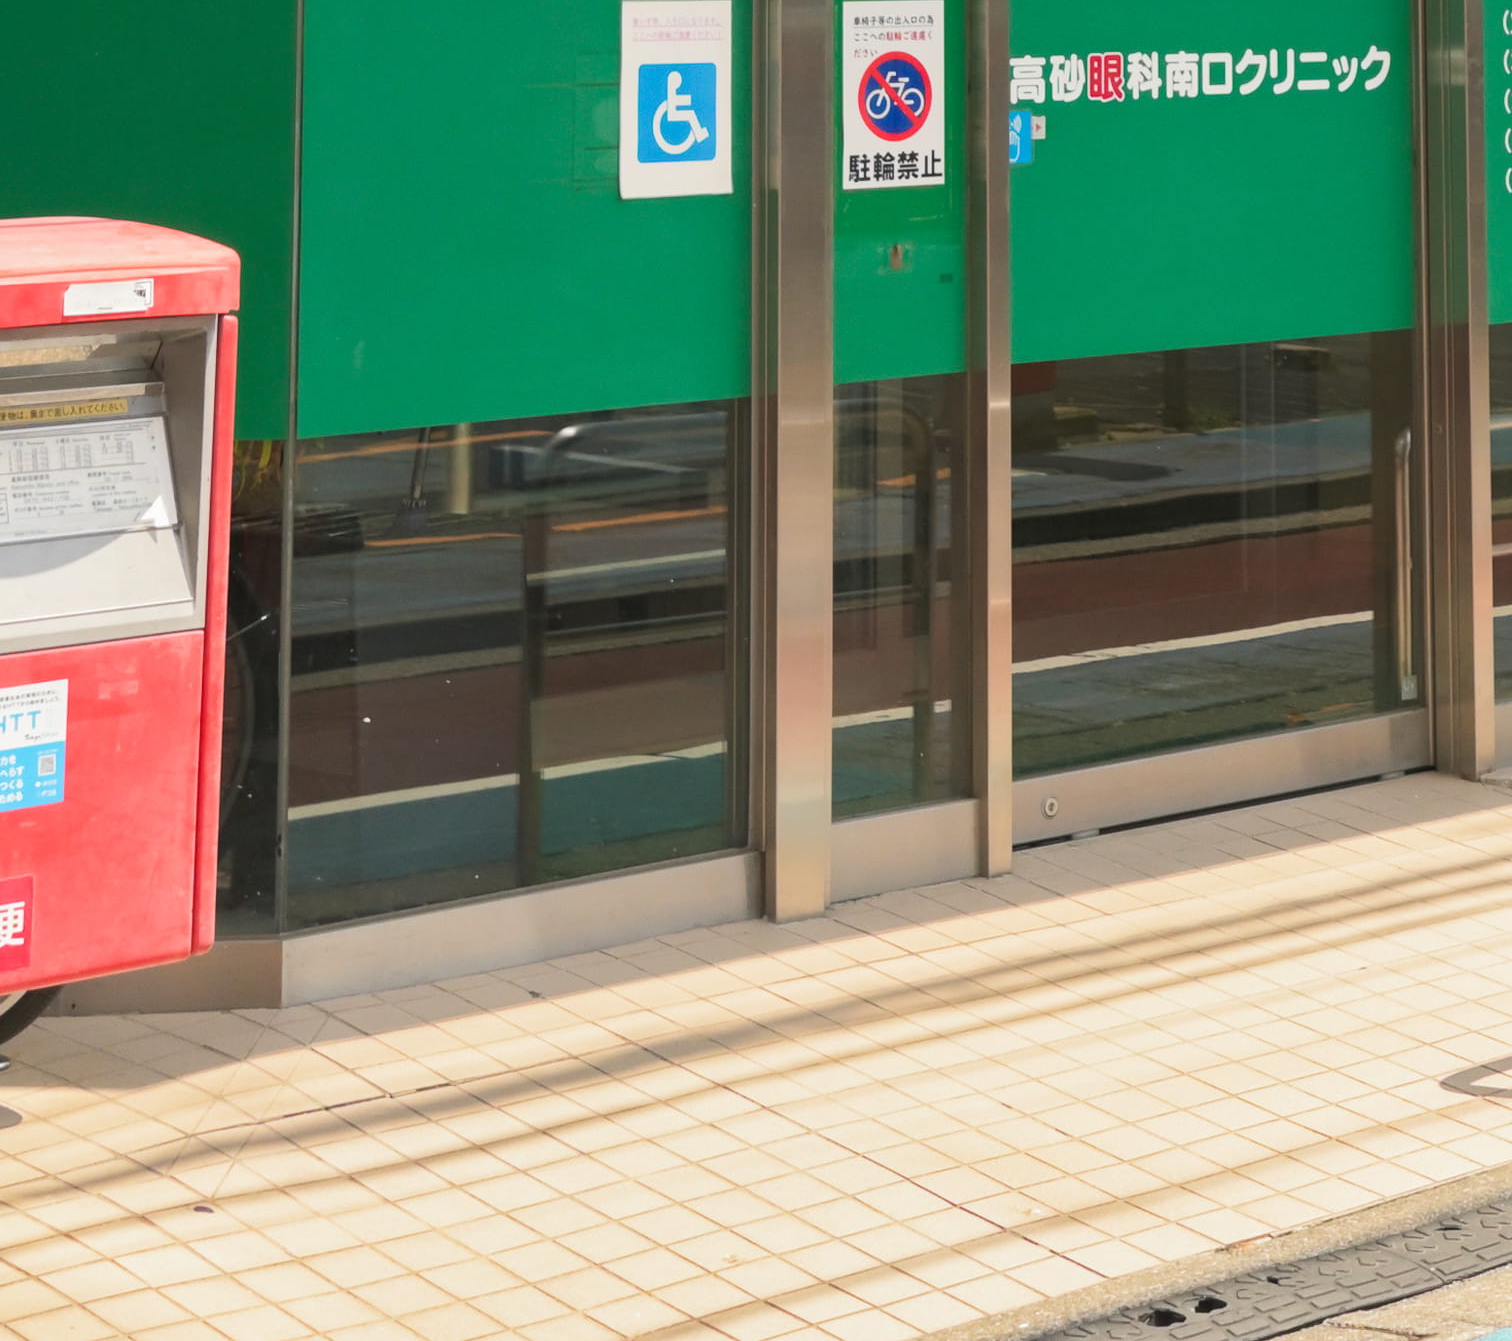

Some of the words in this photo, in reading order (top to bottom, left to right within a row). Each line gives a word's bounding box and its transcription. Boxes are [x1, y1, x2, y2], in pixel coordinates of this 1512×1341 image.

[853, 48, 879, 59] ださい
[1009, 45, 1392, 106] 高砂眼科南口クリニック
[849, 149, 943, 183] 駐輪禁止
